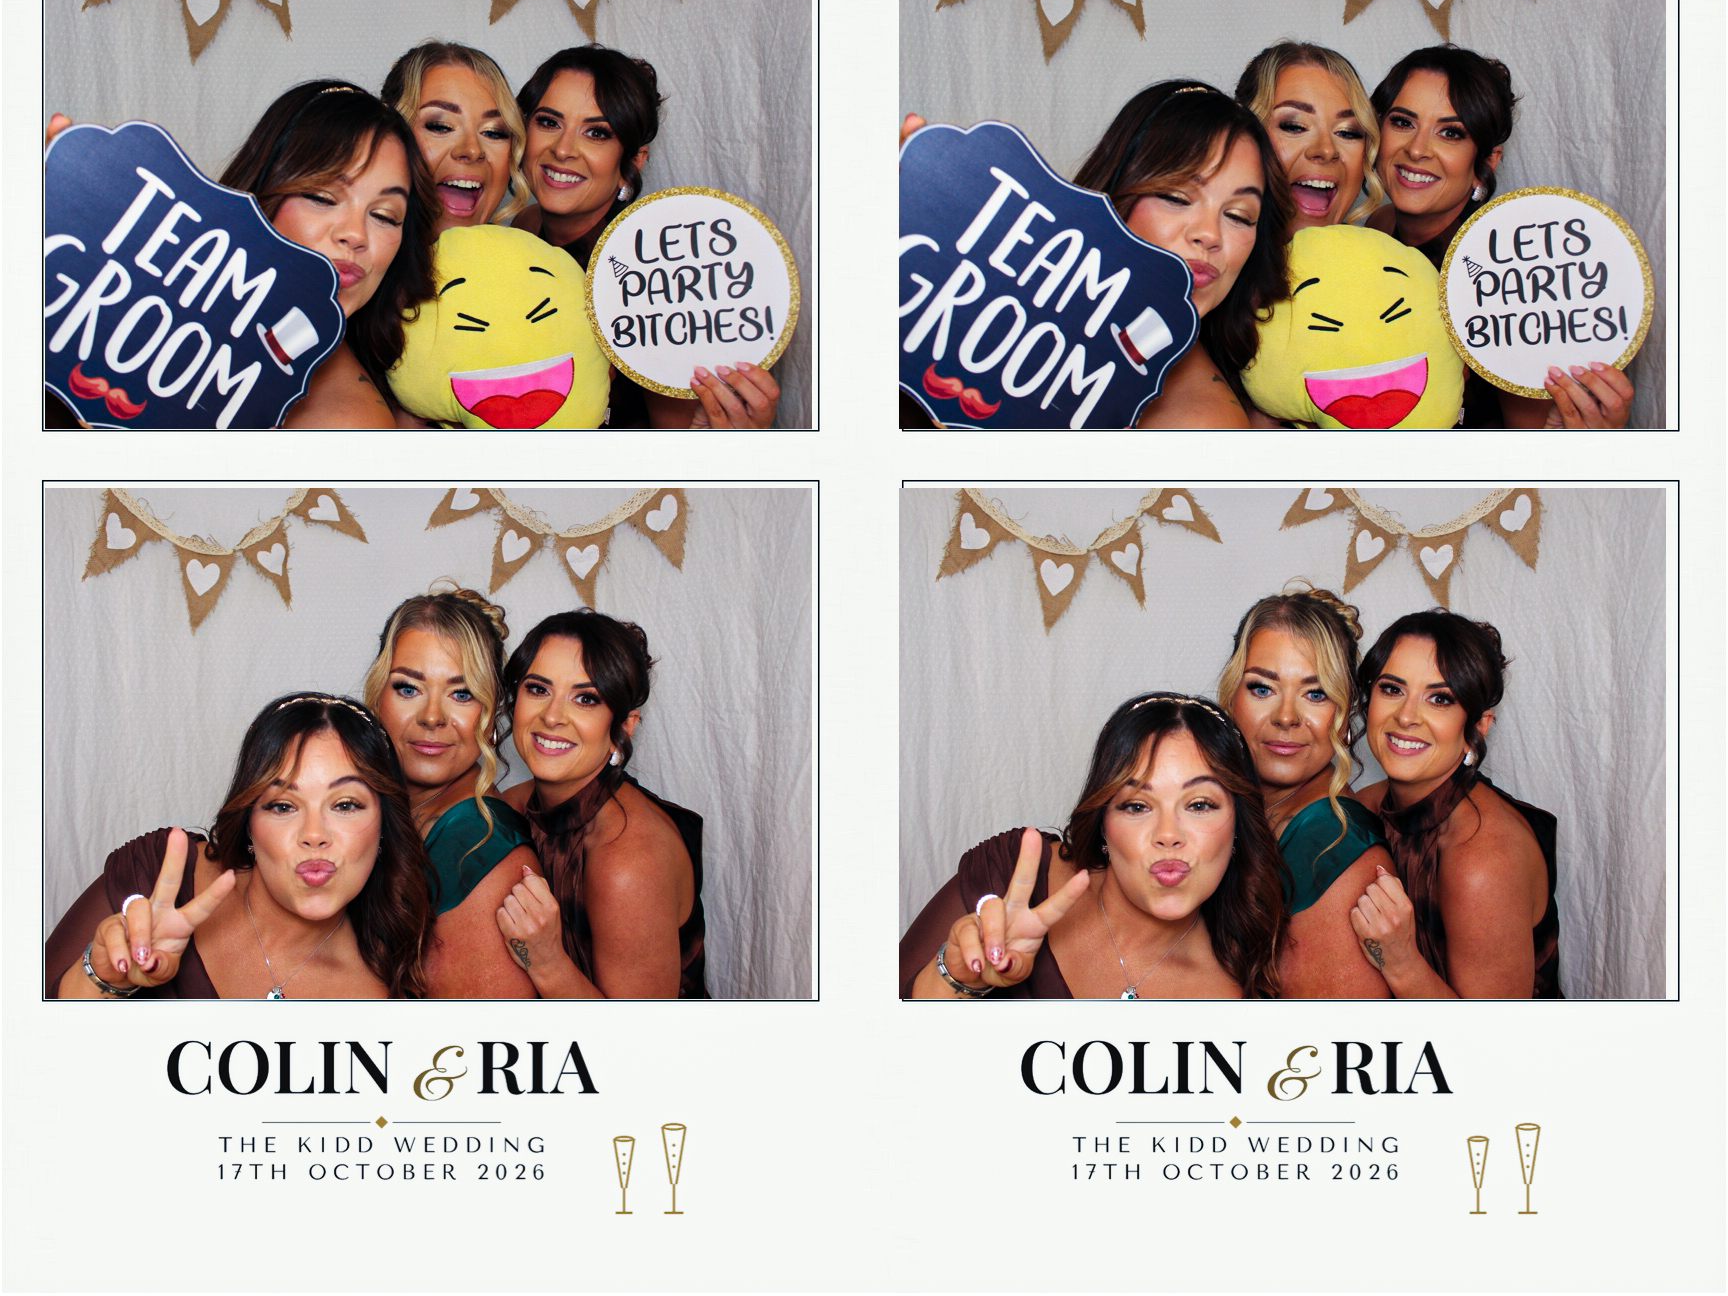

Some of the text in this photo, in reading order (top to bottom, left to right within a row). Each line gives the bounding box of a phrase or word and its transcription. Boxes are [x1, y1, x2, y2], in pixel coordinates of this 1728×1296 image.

[101, 166, 277, 338] TEAM
[634, 218, 737, 264] LETS
[955, 166, 1131, 338] TEAM
[1488, 218, 1591, 264] LETS
[618, 261, 754, 307] PARTY
[1472, 261, 1608, 307] PARTY
[611, 305, 775, 348] BITCHES!
[1465, 305, 1629, 348] BITCHES!
